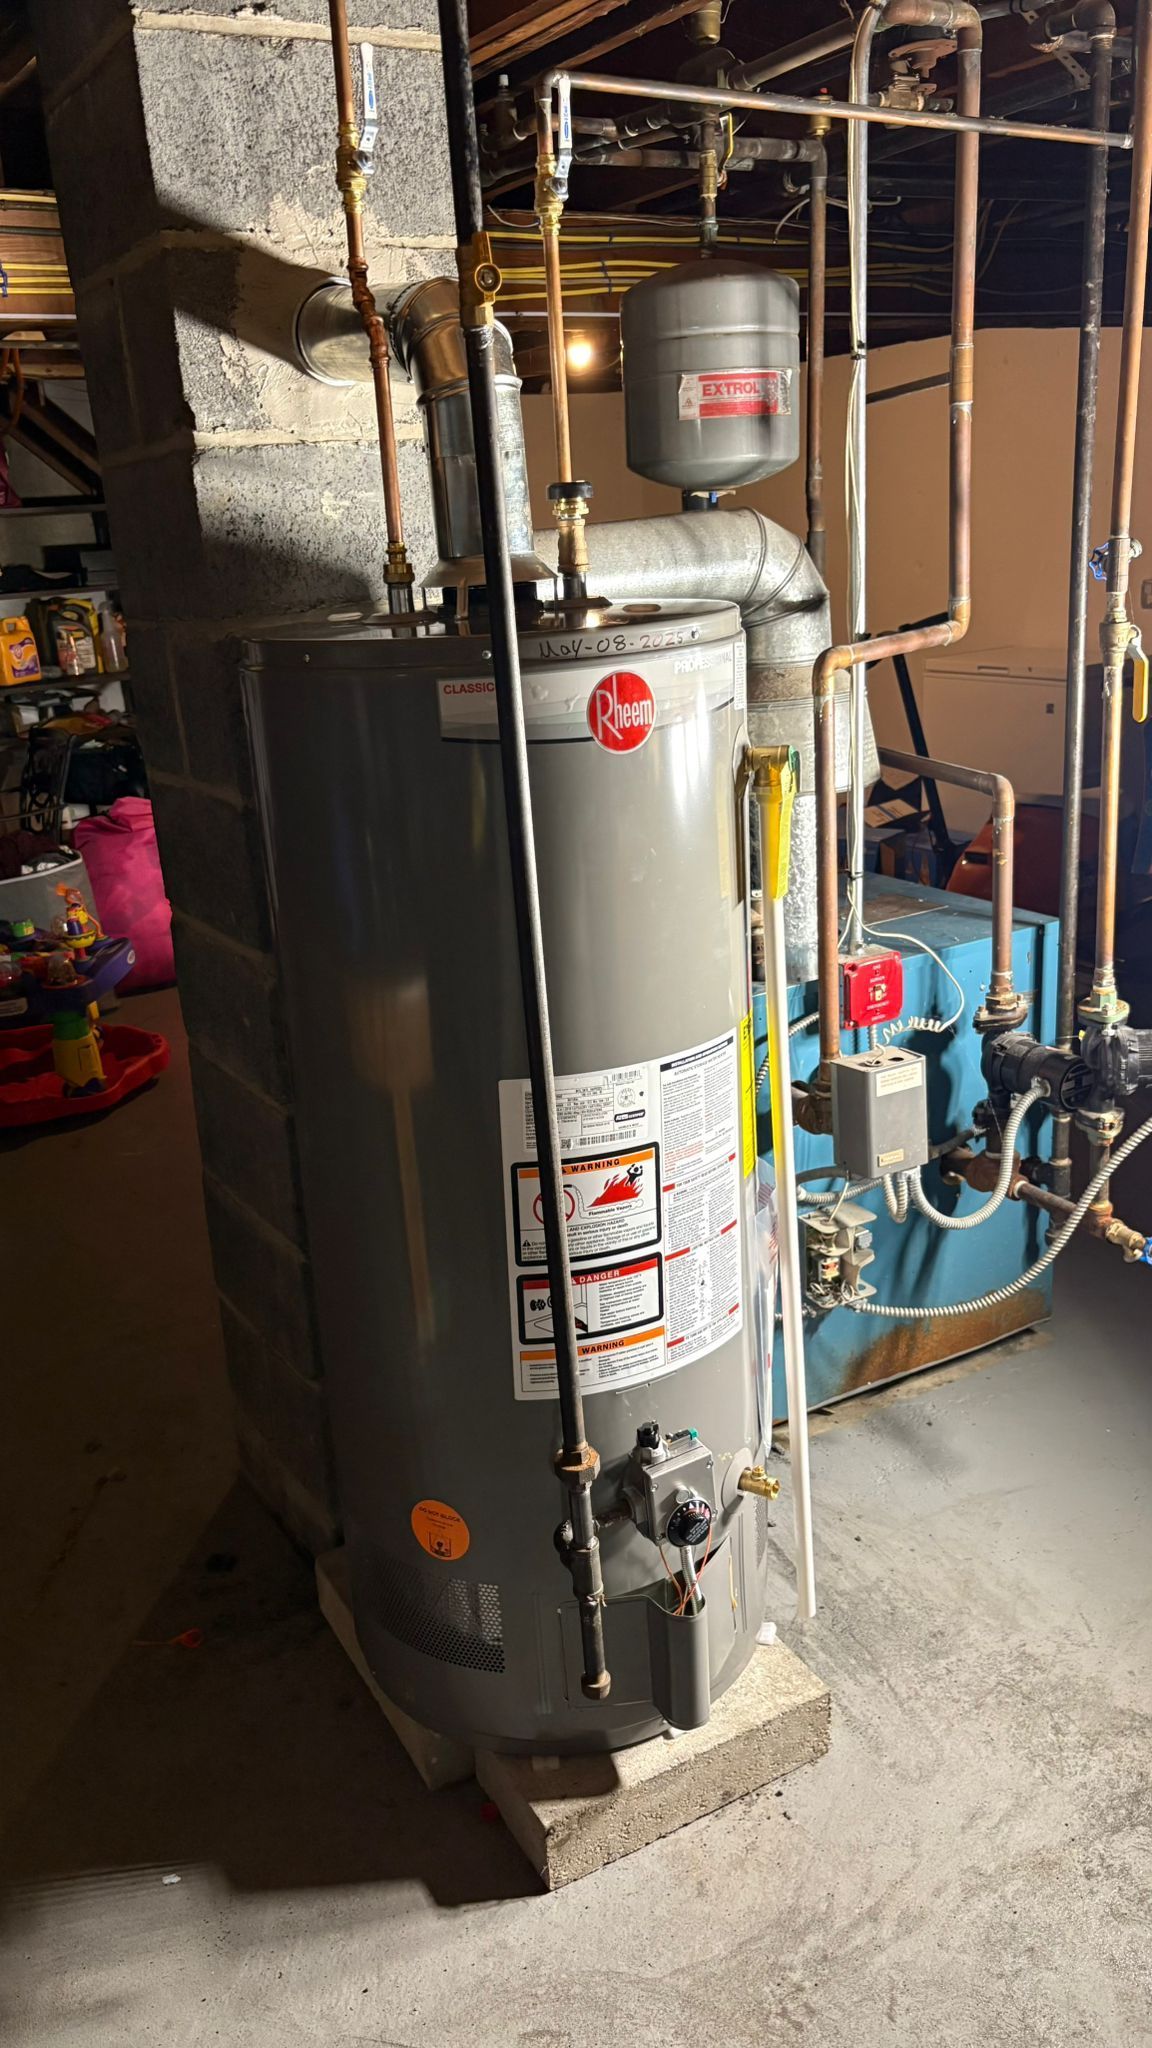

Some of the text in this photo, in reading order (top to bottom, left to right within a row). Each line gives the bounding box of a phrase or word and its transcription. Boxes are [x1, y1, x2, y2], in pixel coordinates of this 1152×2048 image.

[702, 382, 760, 396] EXTROL
[444, 682, 494, 694] CLASSIC
[597, 674, 654, 740] Rheem
[571, 1158, 620, 1172] WARNING
[589, 1208, 615, 1216] Flammable
[580, 1269, 620, 1283] DANGER
[582, 1340, 624, 1354] WARNING
